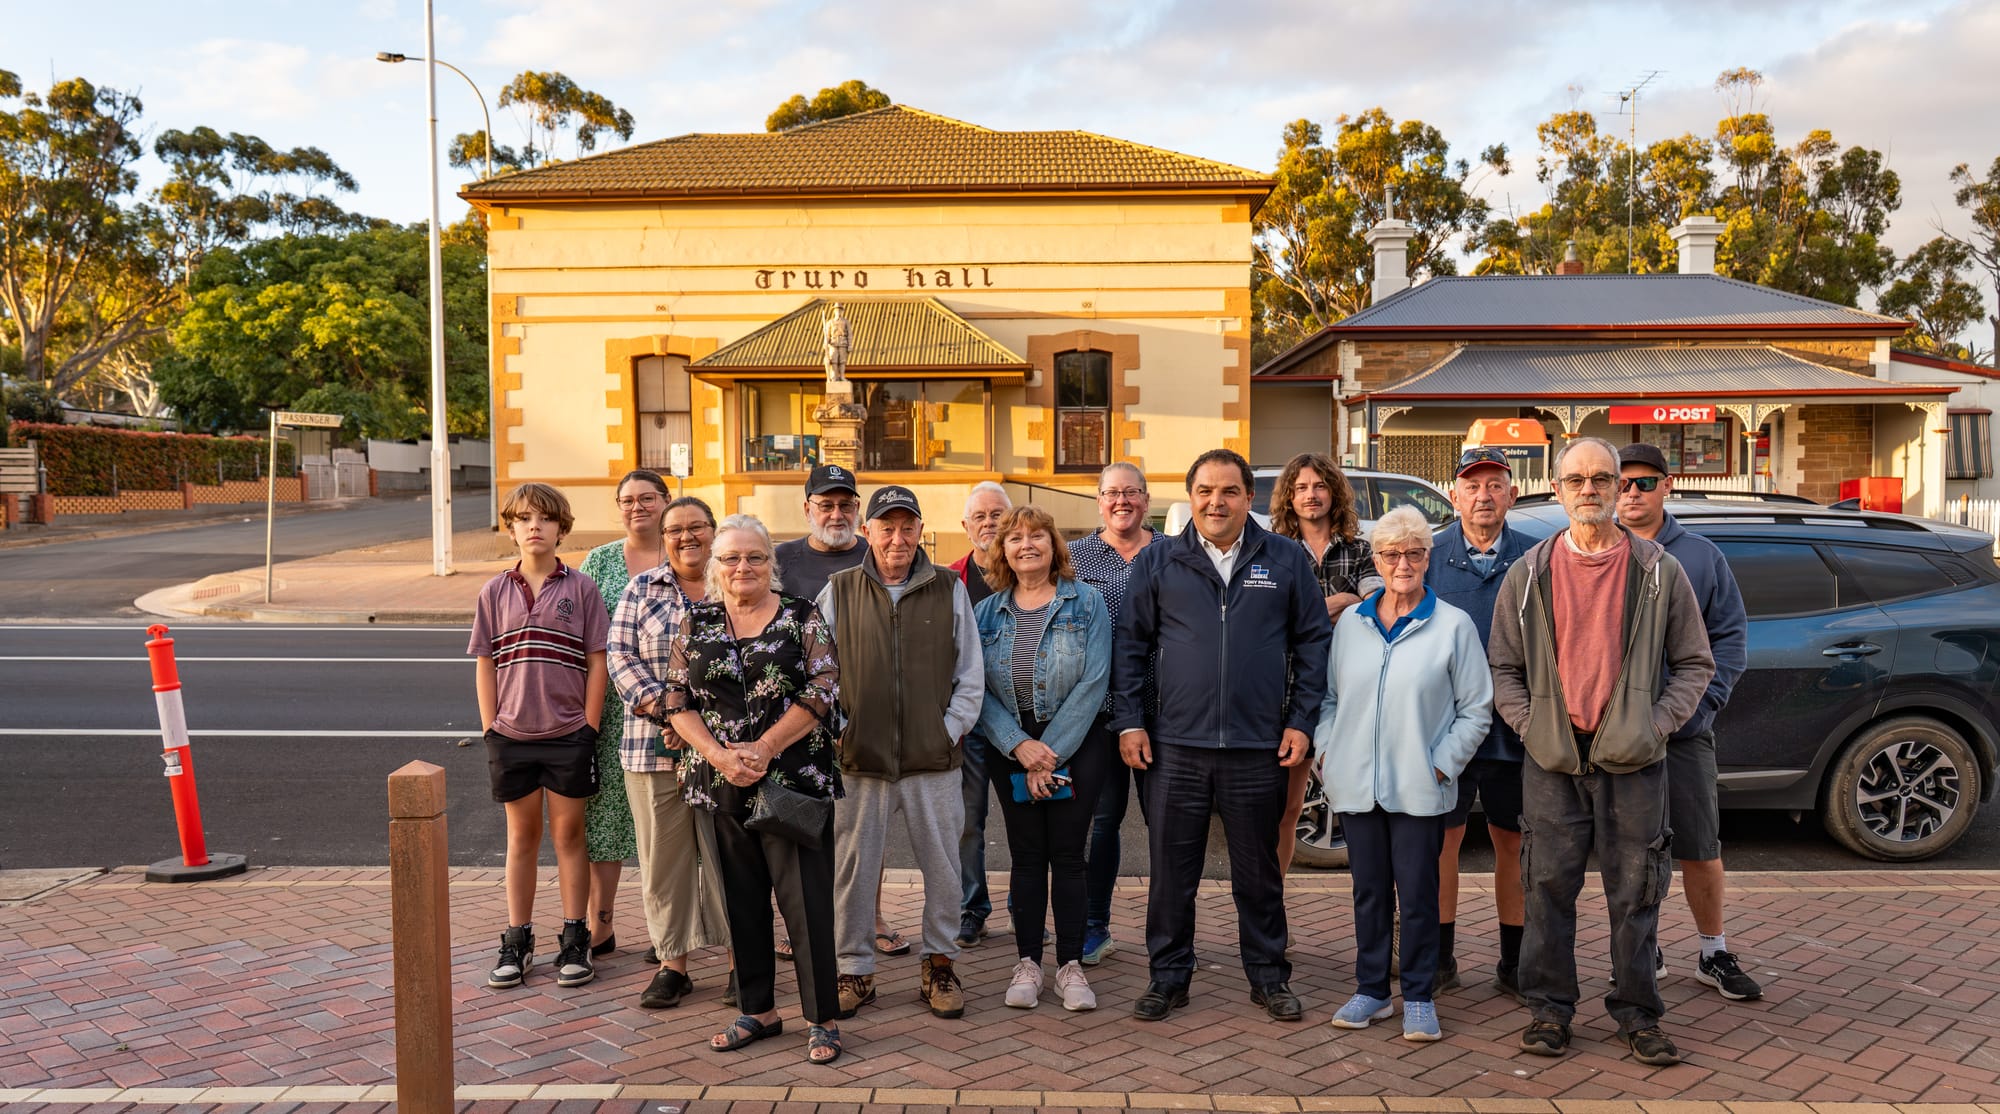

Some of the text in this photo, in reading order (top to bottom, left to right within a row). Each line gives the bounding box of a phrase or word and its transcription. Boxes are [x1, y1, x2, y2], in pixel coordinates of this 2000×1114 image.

[755, 269, 869, 289] Truro
[284, 413, 330, 425] PASSENGER
[1669, 407, 1710, 420] POST
[1501, 448, 1528, 456] Telstra
